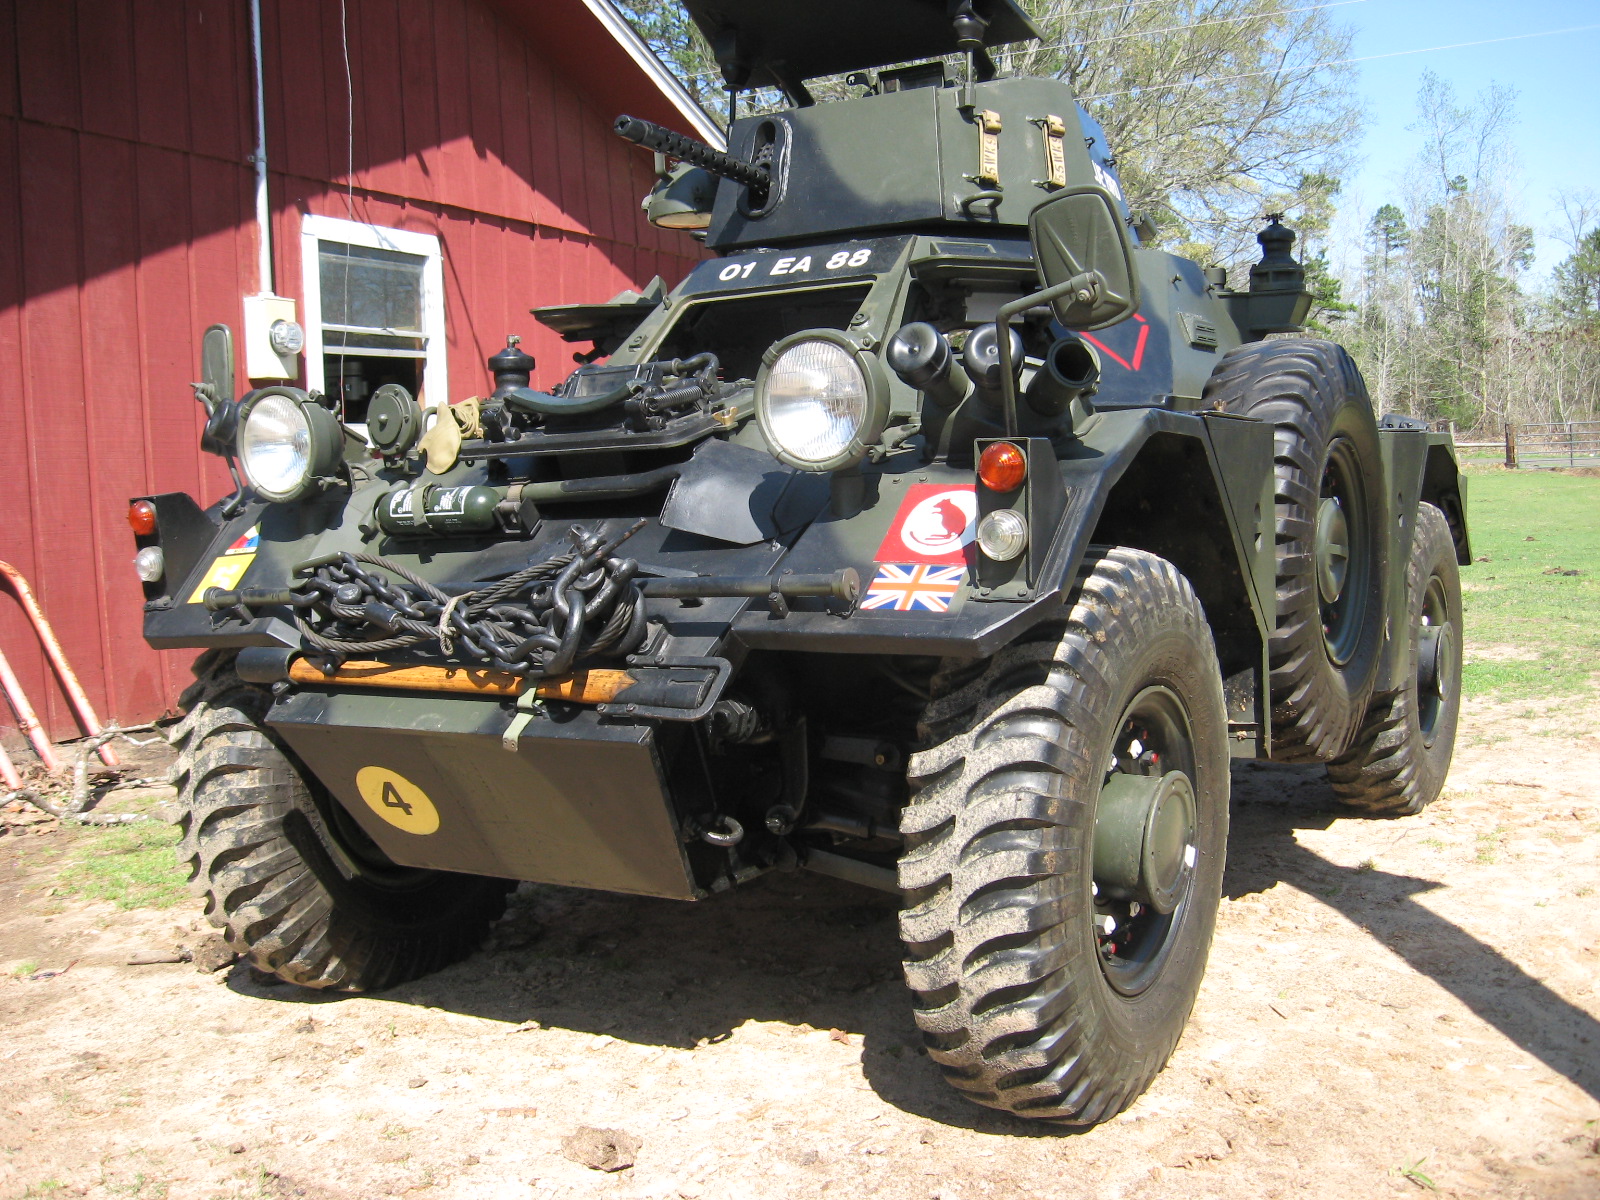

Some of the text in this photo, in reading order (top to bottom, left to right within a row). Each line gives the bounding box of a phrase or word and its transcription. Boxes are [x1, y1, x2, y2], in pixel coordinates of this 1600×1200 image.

[718, 249, 872, 281] 01 EA 88
[381, 781, 413, 816] 4
